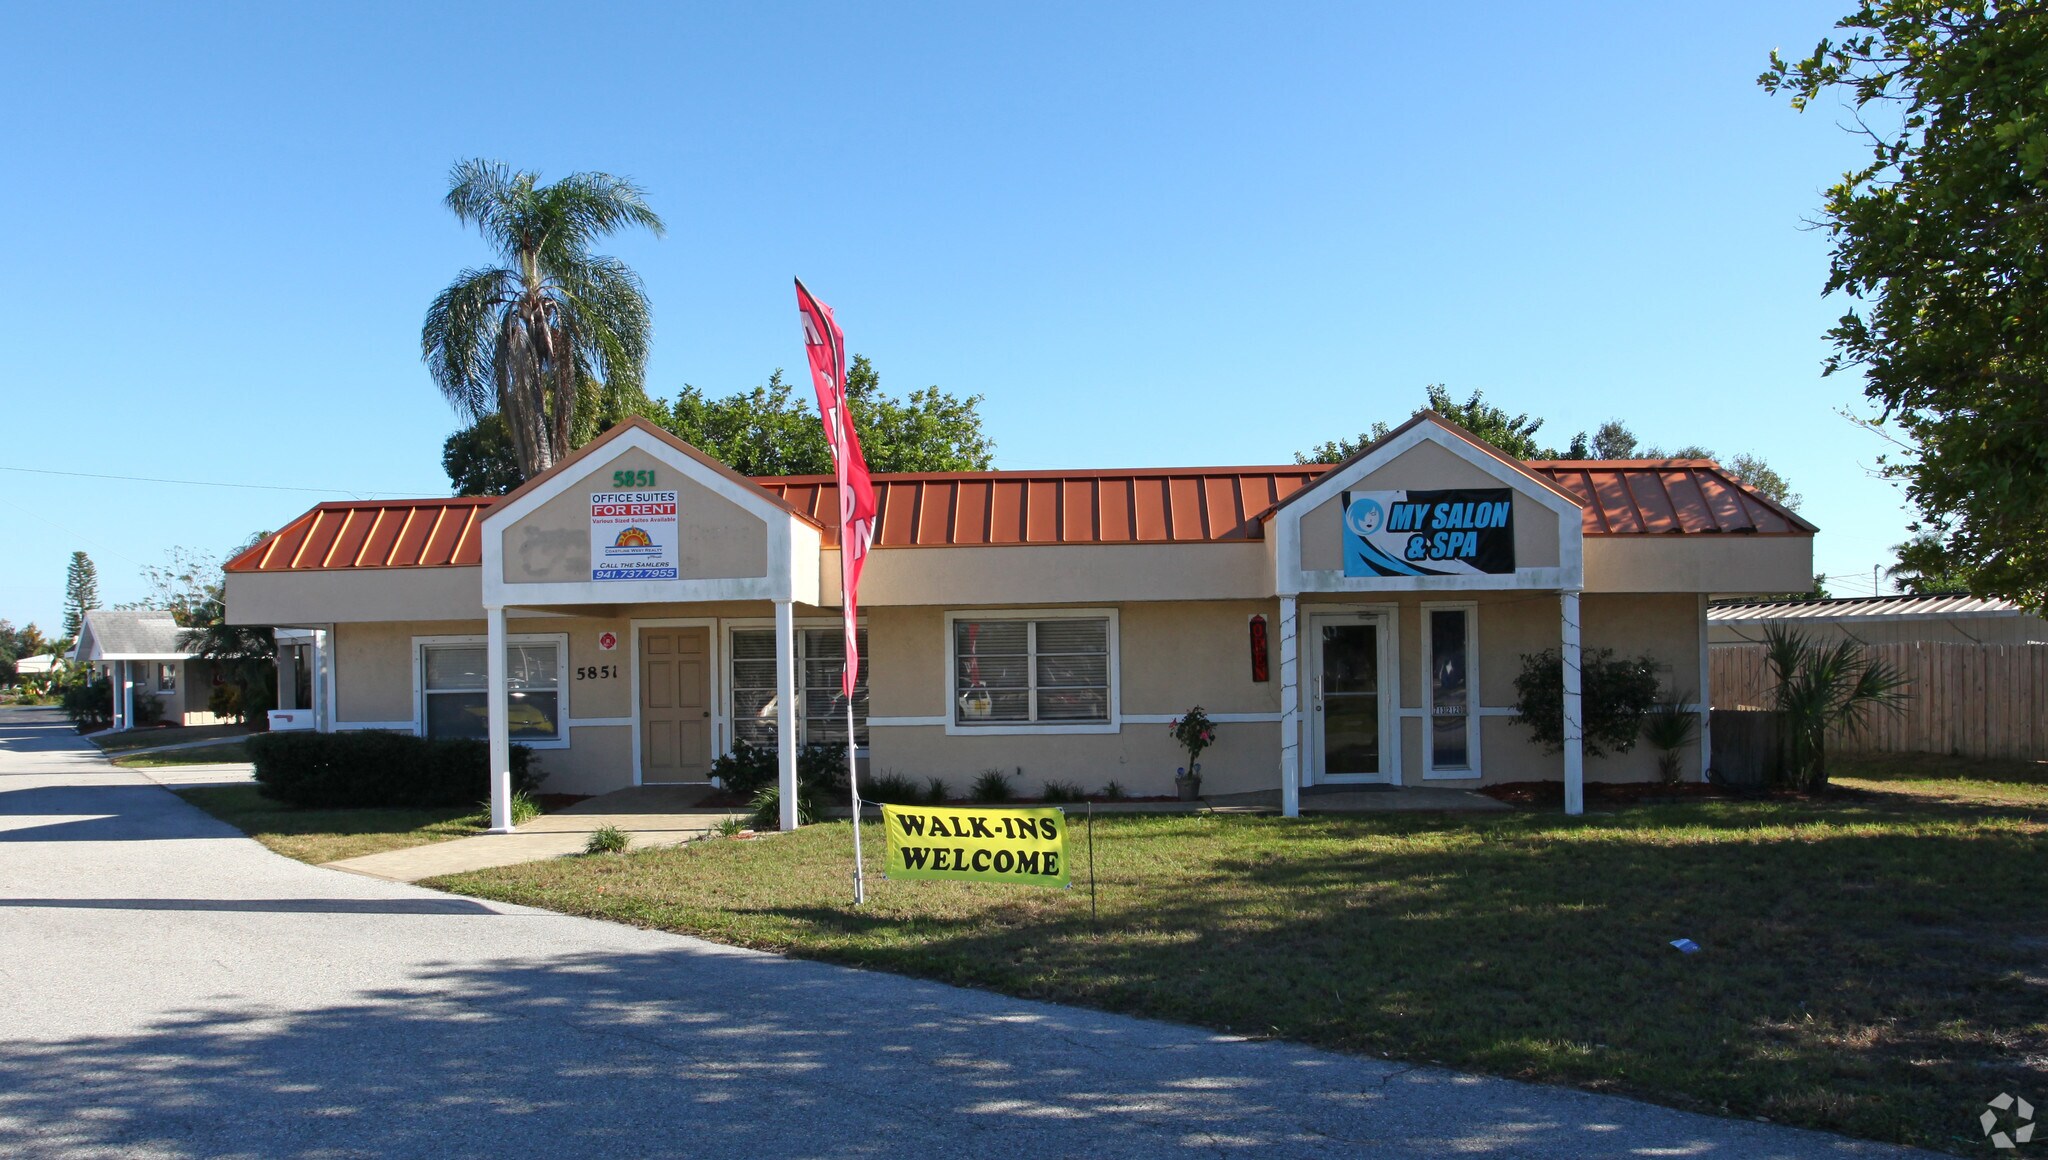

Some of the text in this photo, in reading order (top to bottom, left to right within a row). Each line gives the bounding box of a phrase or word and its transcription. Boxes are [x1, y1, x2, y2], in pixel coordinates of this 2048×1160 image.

[613, 469, 656, 488] 5851
[592, 492, 675, 503] OFFICE SUITES
[594, 504, 674, 515] FOR RENT
[1388, 501, 1510, 530] MY SALON
[1407, 531, 1478, 559] & SPA
[596, 569, 675, 579] 941.737.7955
[576, 665, 617, 680] 5851
[896, 814, 1057, 840] WALK-INS
[901, 847, 1059, 876] WELCOME
